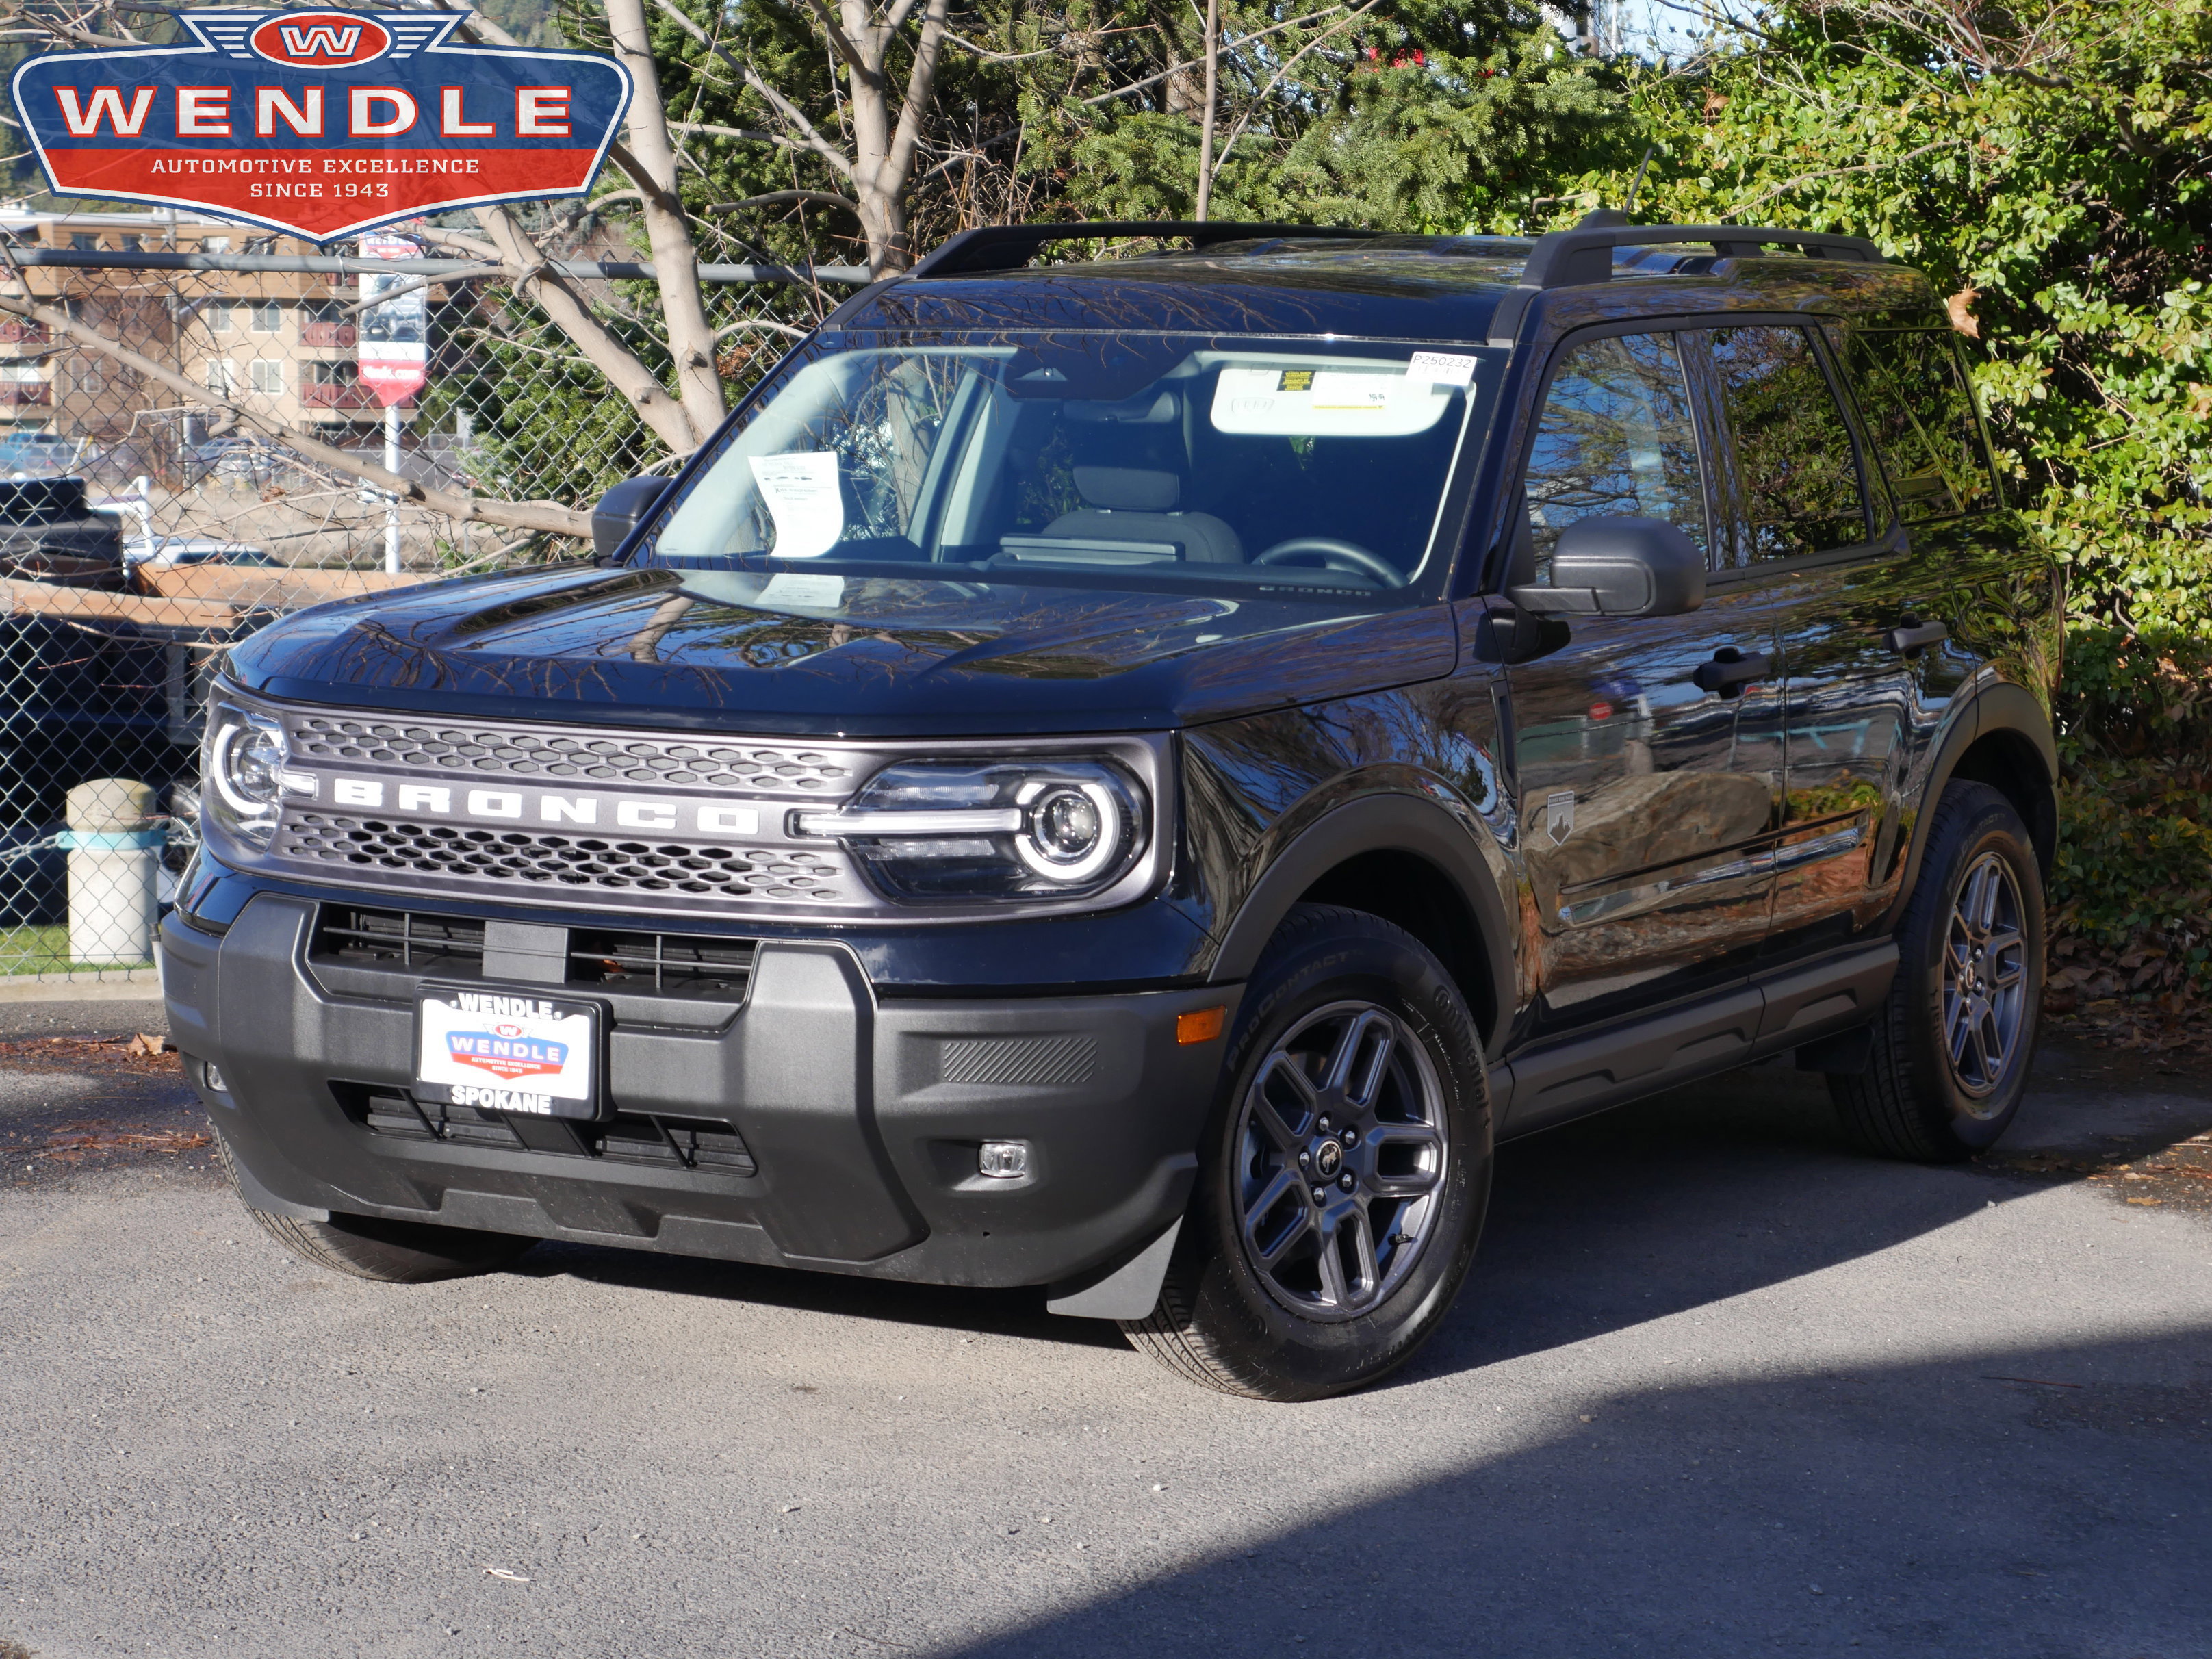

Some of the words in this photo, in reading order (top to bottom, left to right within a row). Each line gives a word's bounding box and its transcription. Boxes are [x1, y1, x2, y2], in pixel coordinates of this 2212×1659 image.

[1413, 355, 1472, 369] P250232
[333, 777, 760, 835] BRONCO
[458, 992, 554, 1021] WENDLE
[452, 1036, 560, 1062] WENDLE
[472, 1057, 506, 1066] AUTOMOTIVE
[452, 1085, 552, 1115] SPOKANE
